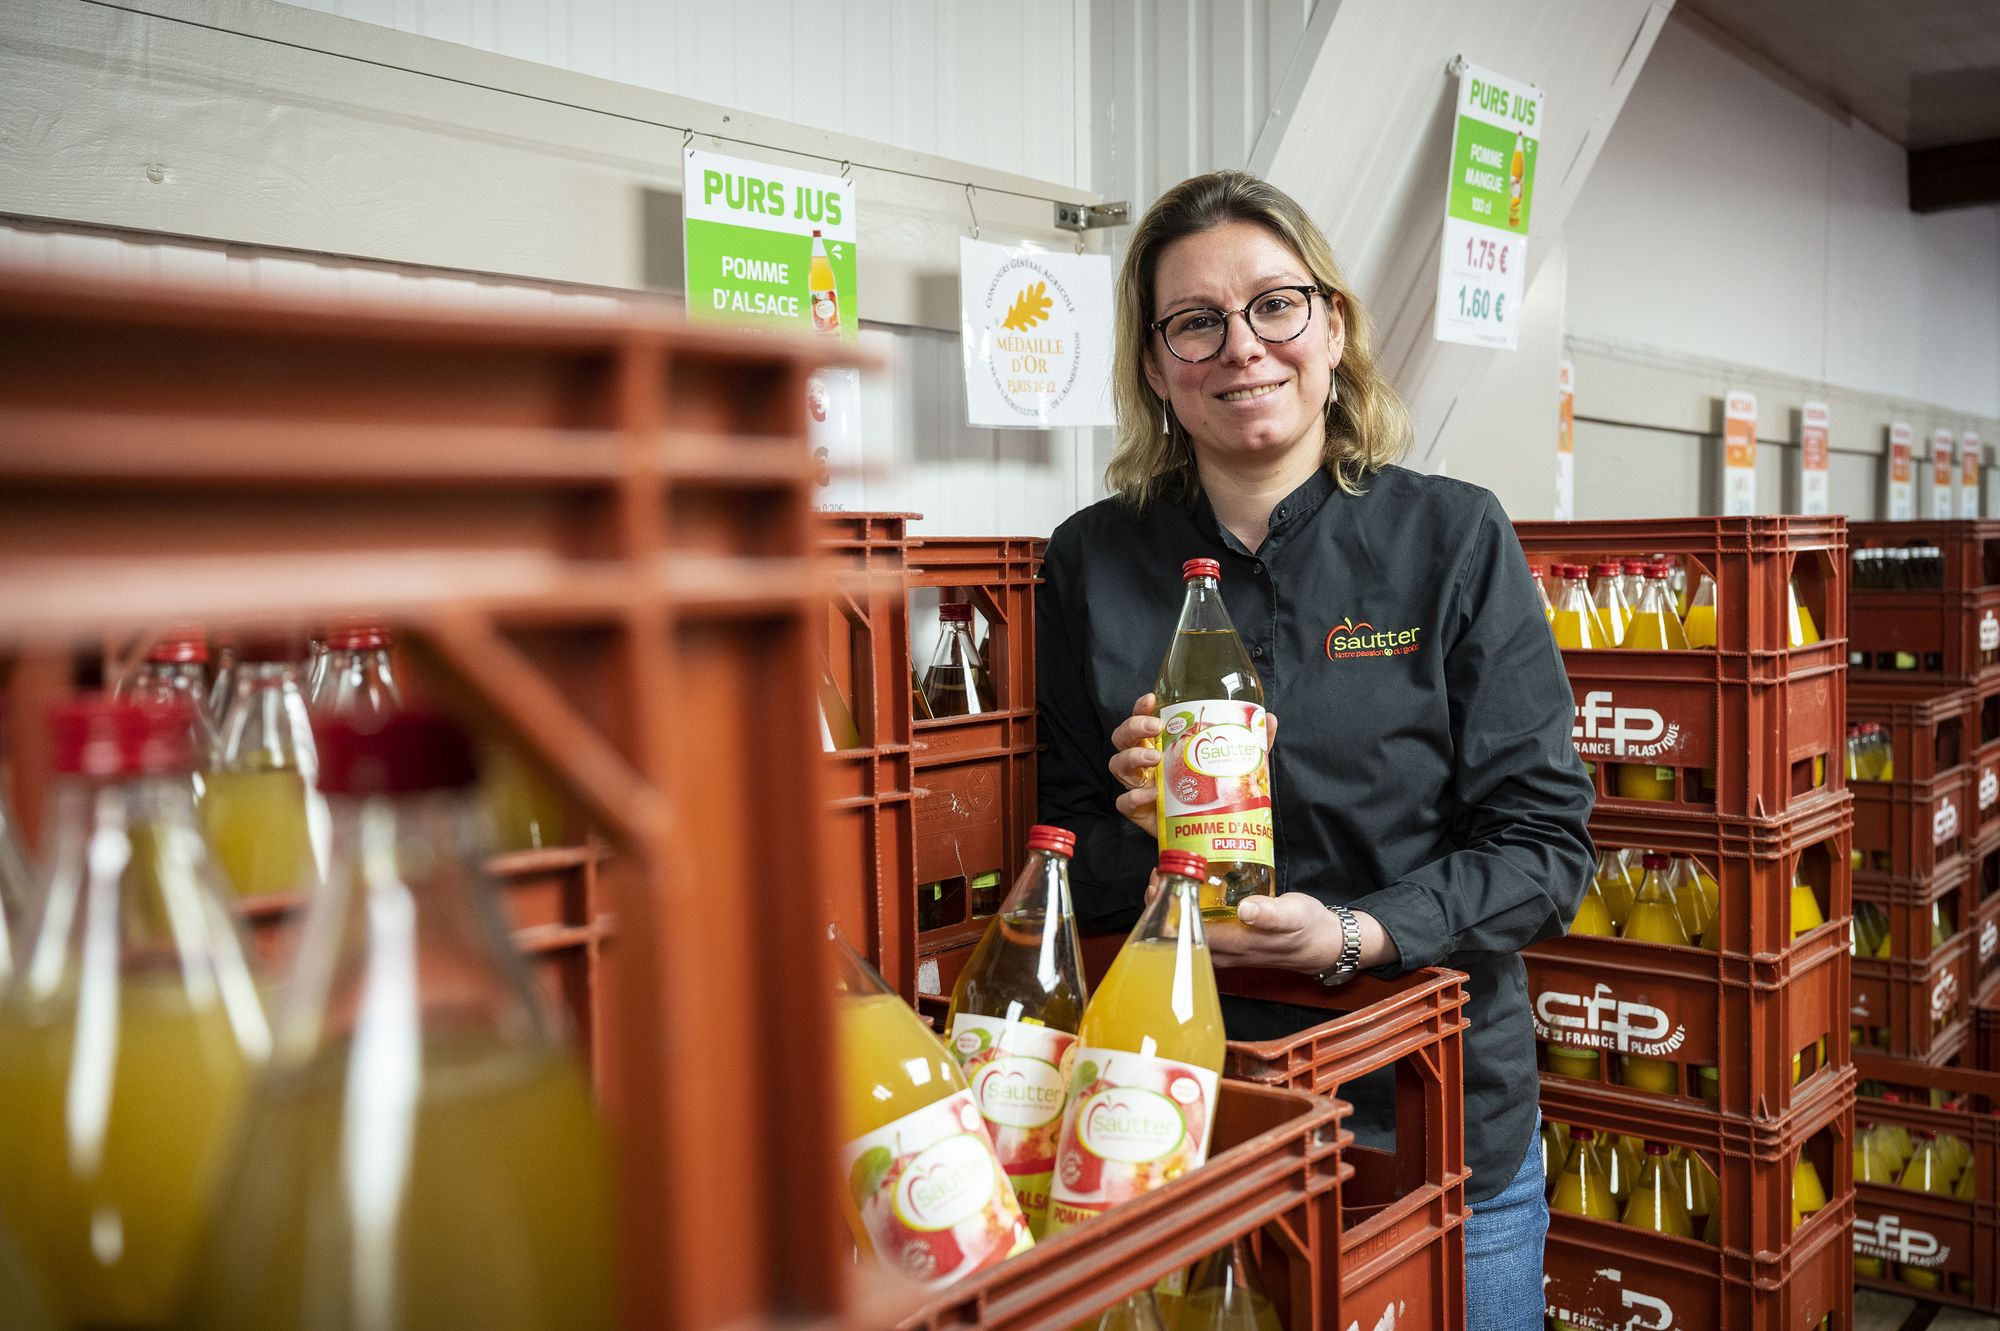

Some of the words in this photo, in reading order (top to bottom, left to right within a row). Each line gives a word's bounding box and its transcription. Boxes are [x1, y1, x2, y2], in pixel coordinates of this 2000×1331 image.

[1469, 79, 1509, 117] PURS
[1511, 94, 1537, 127] JUS
[1470, 143, 1505, 170] POMME
[1464, 166, 1504, 194] MANGUE
[703, 169, 784, 217] PURS
[793, 185, 842, 226] JUS
[1466, 236, 1497, 271] 1.75
[1498, 244, 1510, 274] €
[721, 255, 789, 285] POMME
[712, 287, 800, 318] D'ALSACE
[1458, 285, 1491, 320] 1.60
[1494, 292, 1506, 323] €
[996, 331, 1064, 355] MÉDAILLE
[1011, 354, 1049, 374] D'OR
[1007, 379, 1032, 394] PARIS
[1333, 627, 1421, 651] sautter
[1200, 742, 1257, 759] sautter
[1573, 742, 1611, 755] RANCE
[1628, 722, 1680, 757] PLASTIQUE
[1174, 822, 1225, 839] POMME
[1214, 839, 1236, 849] PUR
[1238, 839, 1255, 850] JUS
[1566, 1031, 1615, 1049] FRANCE
[987, 1081, 1061, 1102] sautter
[1094, 1112, 1175, 1137] sautter
